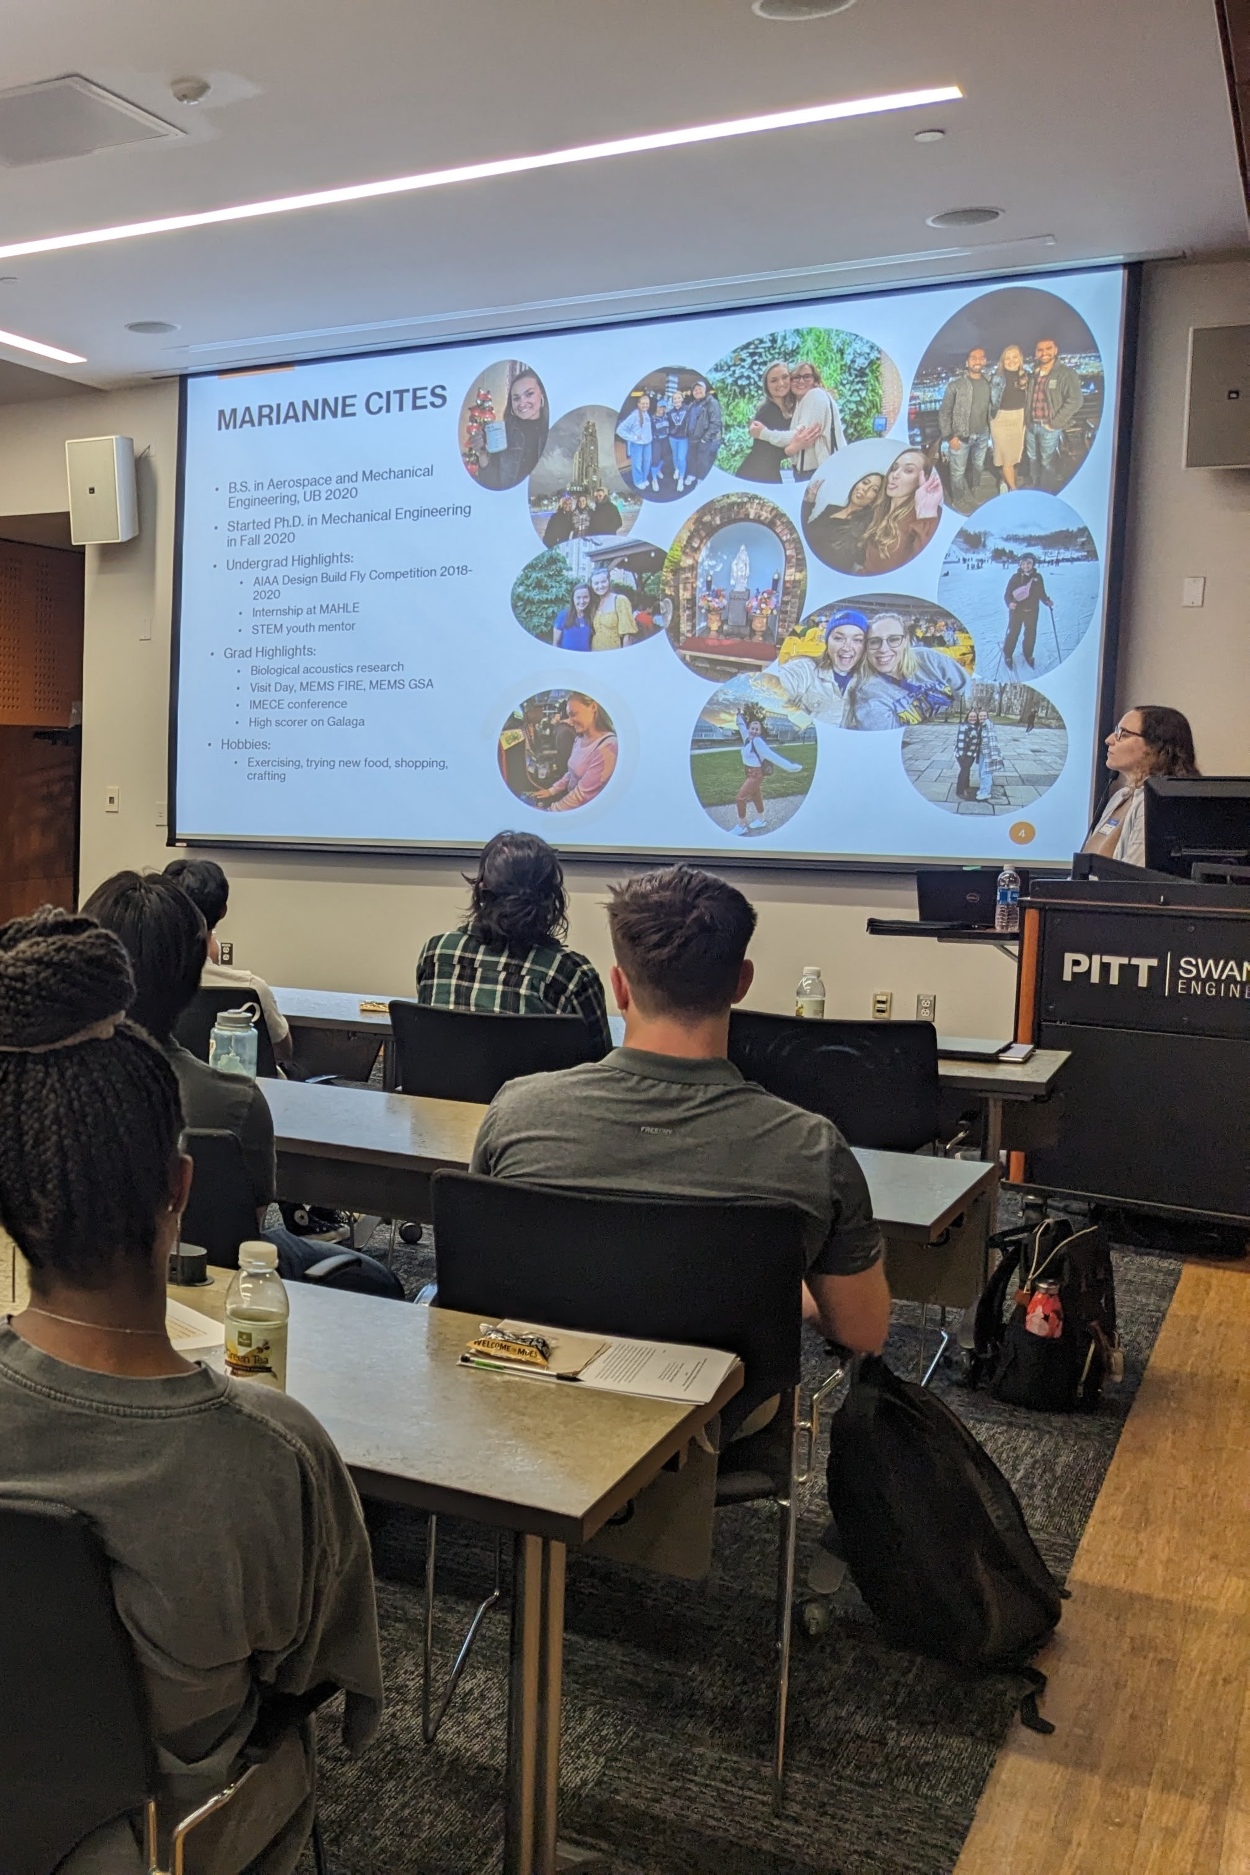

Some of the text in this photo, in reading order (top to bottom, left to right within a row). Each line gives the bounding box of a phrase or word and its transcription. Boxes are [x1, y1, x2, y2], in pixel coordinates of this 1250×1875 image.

[218, 384, 447, 430] MARIANNE CITES
[228, 465, 433, 494] B.S. in Aerospace and Mechanical
[228, 488, 358, 510] Engineering, UB 2020
[228, 504, 471, 533] Started Ph.D. in Mechanical Engineering
[228, 533, 295, 547] in Fall 2020
[227, 554, 353, 571] Undergrad Highlights:
[253, 565, 472, 586] AIAA Design Build Fly Competition 2018-
[253, 590, 280, 600] 2020
[252, 602, 360, 618] Internship at MAHLE
[252, 622, 356, 635] STEM youth mentor
[224, 646, 316, 659] Grad Highlights:
[250, 662, 404, 678] Biological acoustics research
[250, 679, 434, 694] Visit Day, MEMS FIRE, MEMS GSA
[250, 699, 347, 709] IMECE conference
[249, 716, 365, 729] High scorer on Galaga
[221, 739, 270, 750] Hobbies:
[247, 758, 448, 771] Exercising, trying new food, shopping,
[247, 771, 286, 782] crafting
[1018, 829, 1026, 837] 4
[1062, 952, 1158, 988] PITT
[474, 1340, 511, 1352] WELCOME
